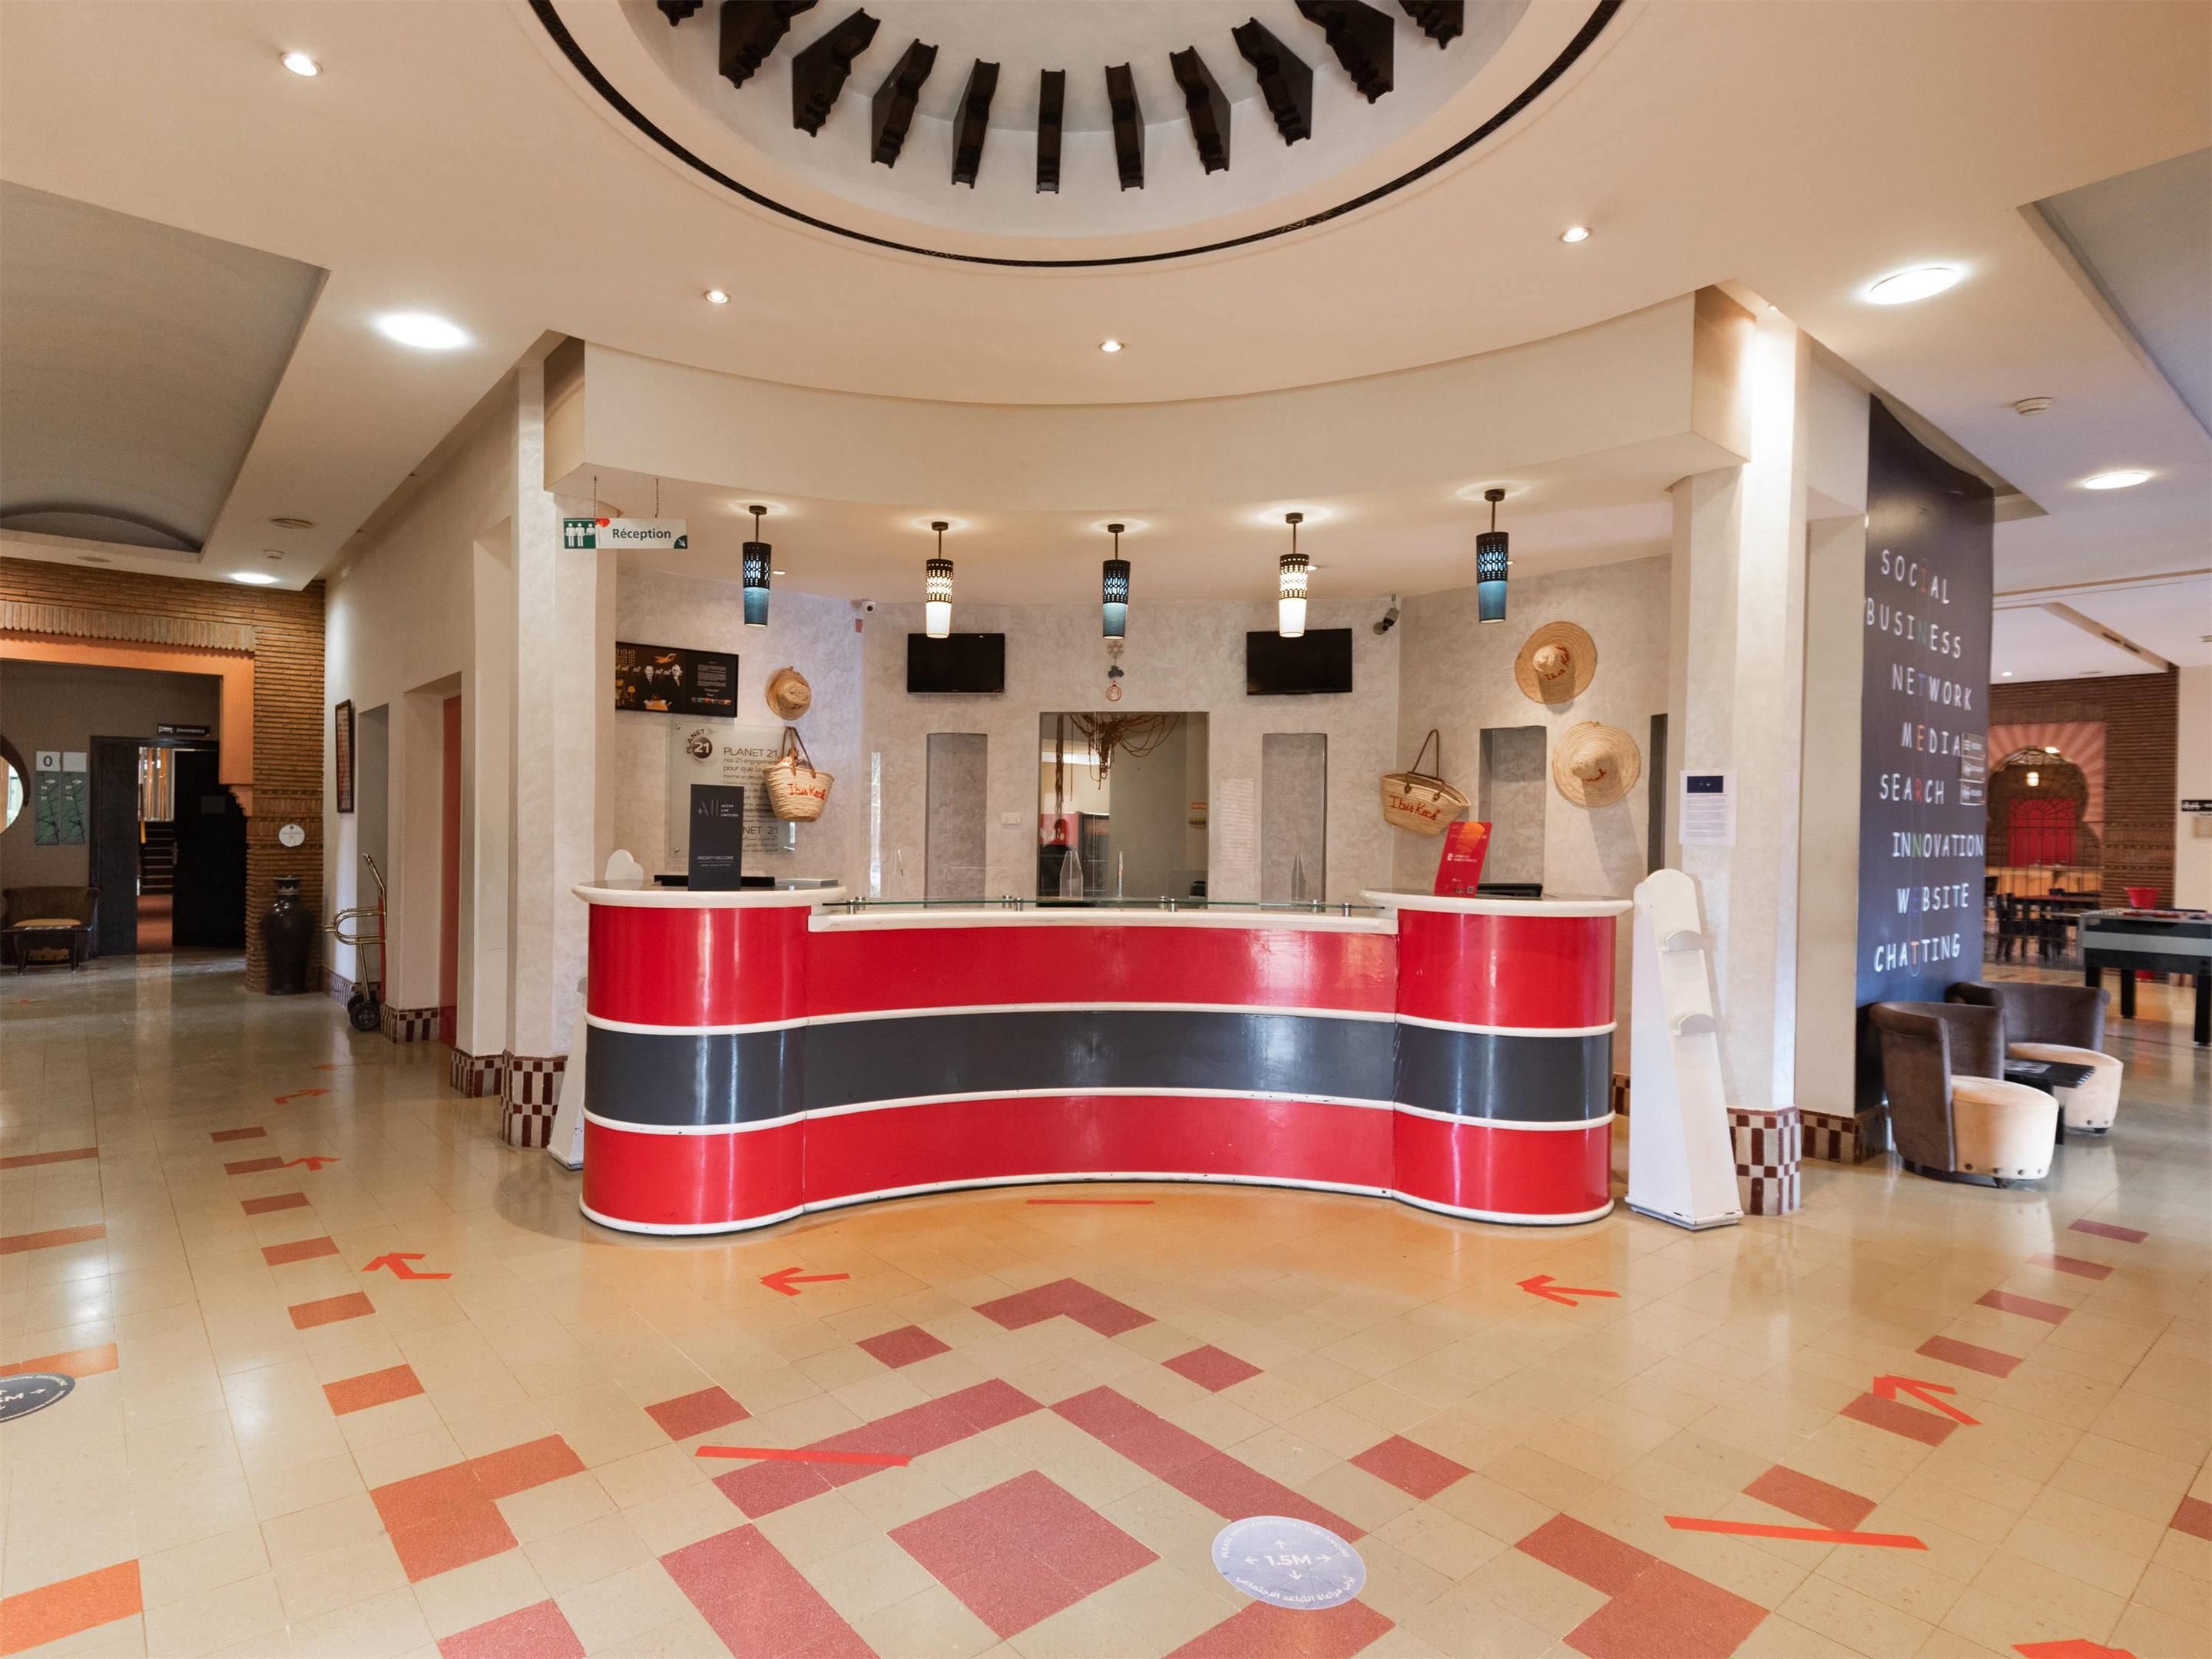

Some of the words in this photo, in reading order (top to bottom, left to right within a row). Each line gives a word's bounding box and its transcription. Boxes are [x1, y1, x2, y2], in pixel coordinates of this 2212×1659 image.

[612, 528, 671, 541] Réception
[1881, 549, 1950, 604] SOCIAL
[1866, 597, 1961, 658] BUSINESS
[1892, 663, 1972, 710] NETWORK
[694, 742, 710, 753] 21
[724, 747, 764, 757] PLANET
[1901, 721, 1961, 757] MEDIA
[1879, 773, 1945, 804] SEARCH
[1892, 831, 1984, 858] INNOVATION
[1896, 882, 1969, 914] WEBSITE
[1874, 933, 1960, 972] CHATTING
[1263, 1554, 1313, 1566] 1.5M
